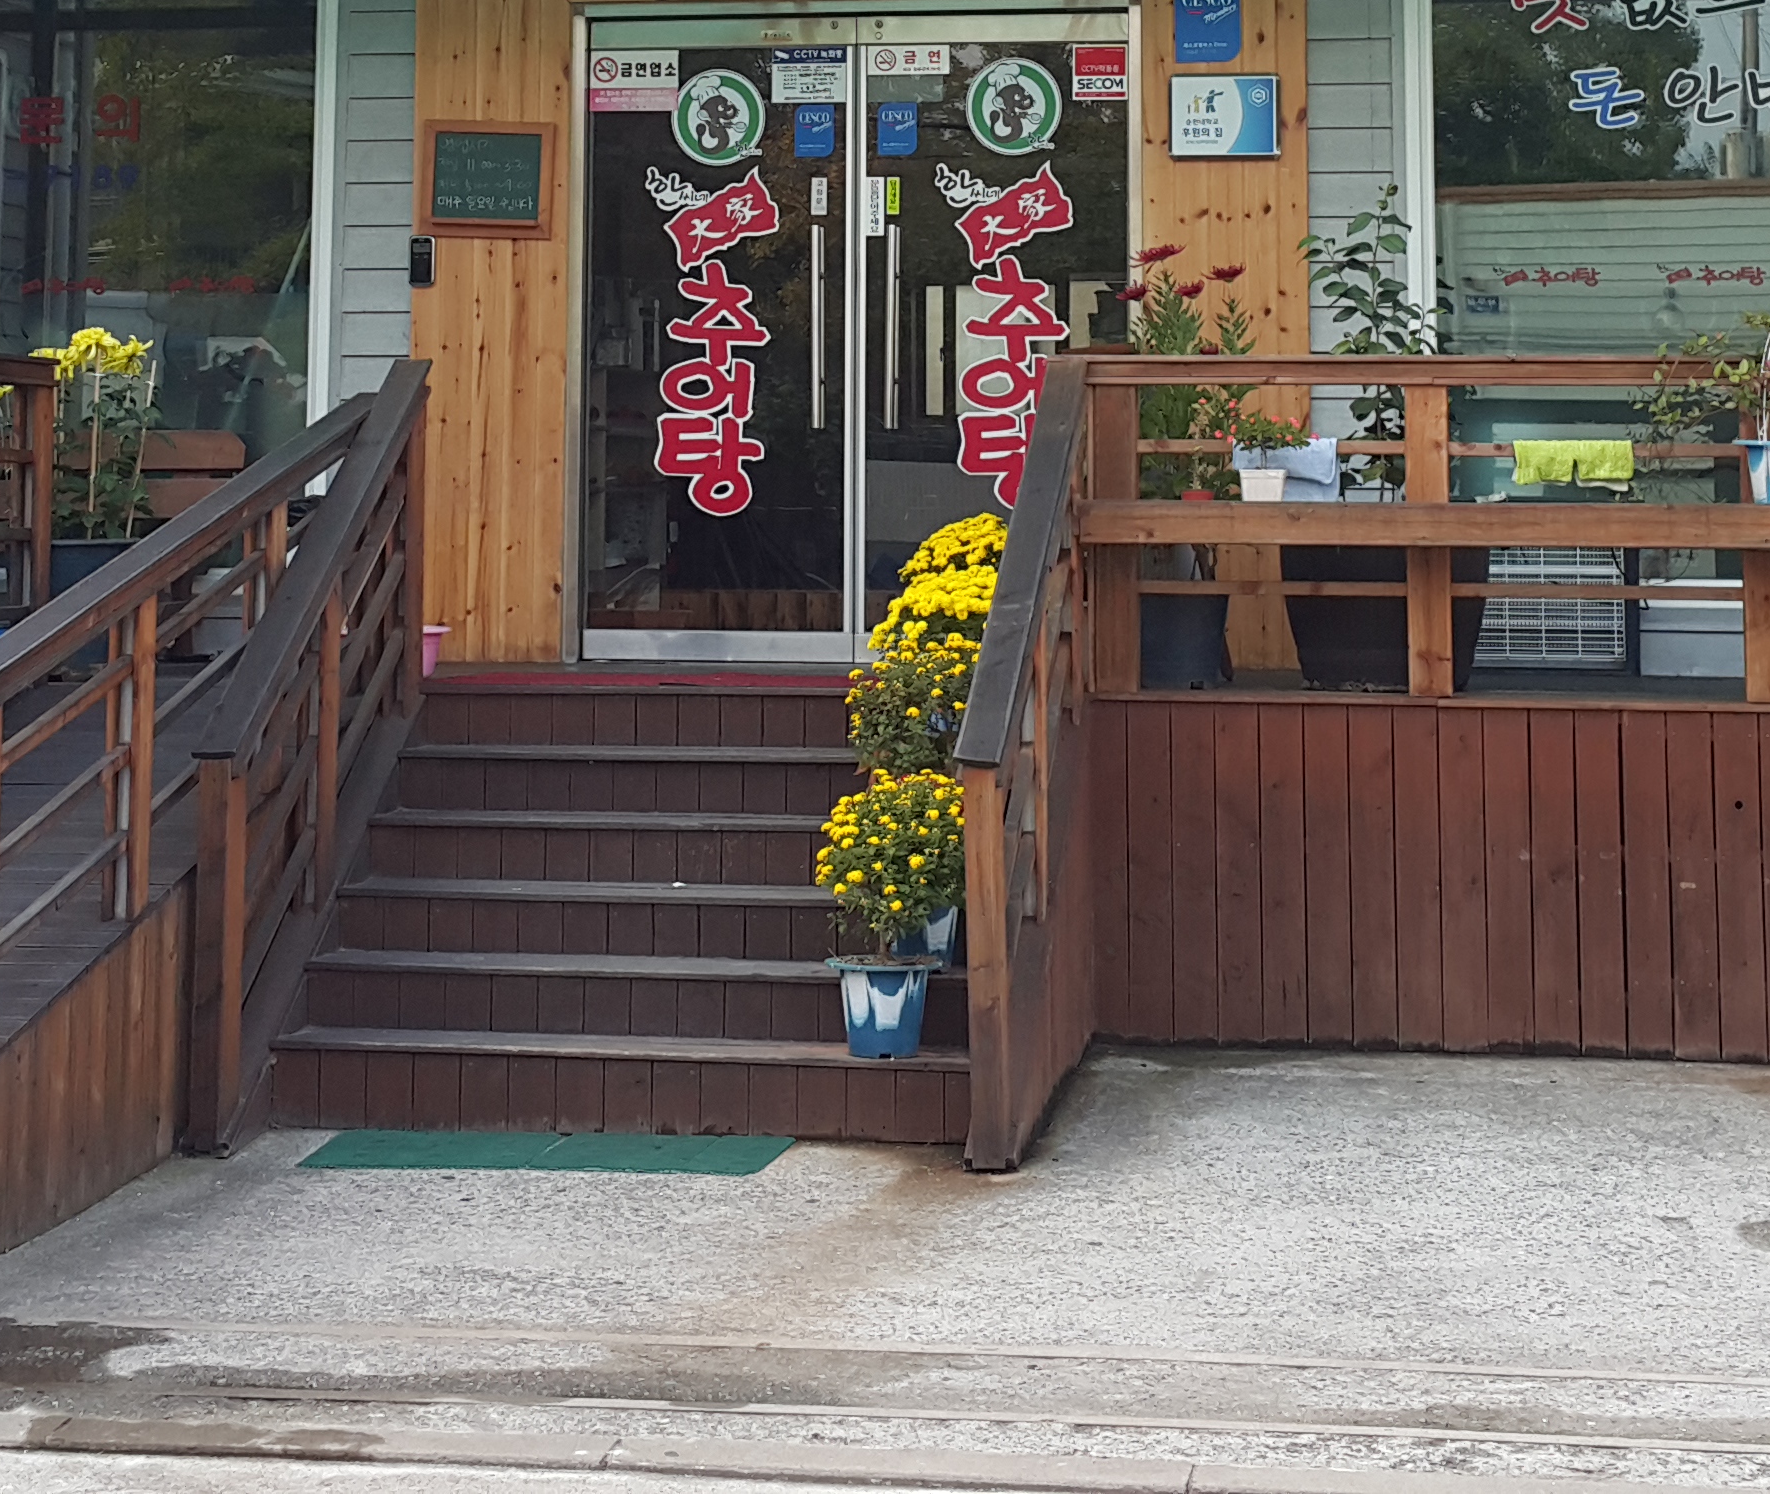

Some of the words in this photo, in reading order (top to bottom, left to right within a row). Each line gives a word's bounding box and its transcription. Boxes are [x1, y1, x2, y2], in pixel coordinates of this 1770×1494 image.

[794, 50, 818, 59] CCTV
[620, 62, 676, 78] 금연업소
[1077, 77, 1123, 91] SECOM
[1569, 66, 1645, 129] 돈
[799, 111, 829, 124] CESCO
[882, 110, 912, 122] CESCO
[655, 260, 771, 516] 추어탕
